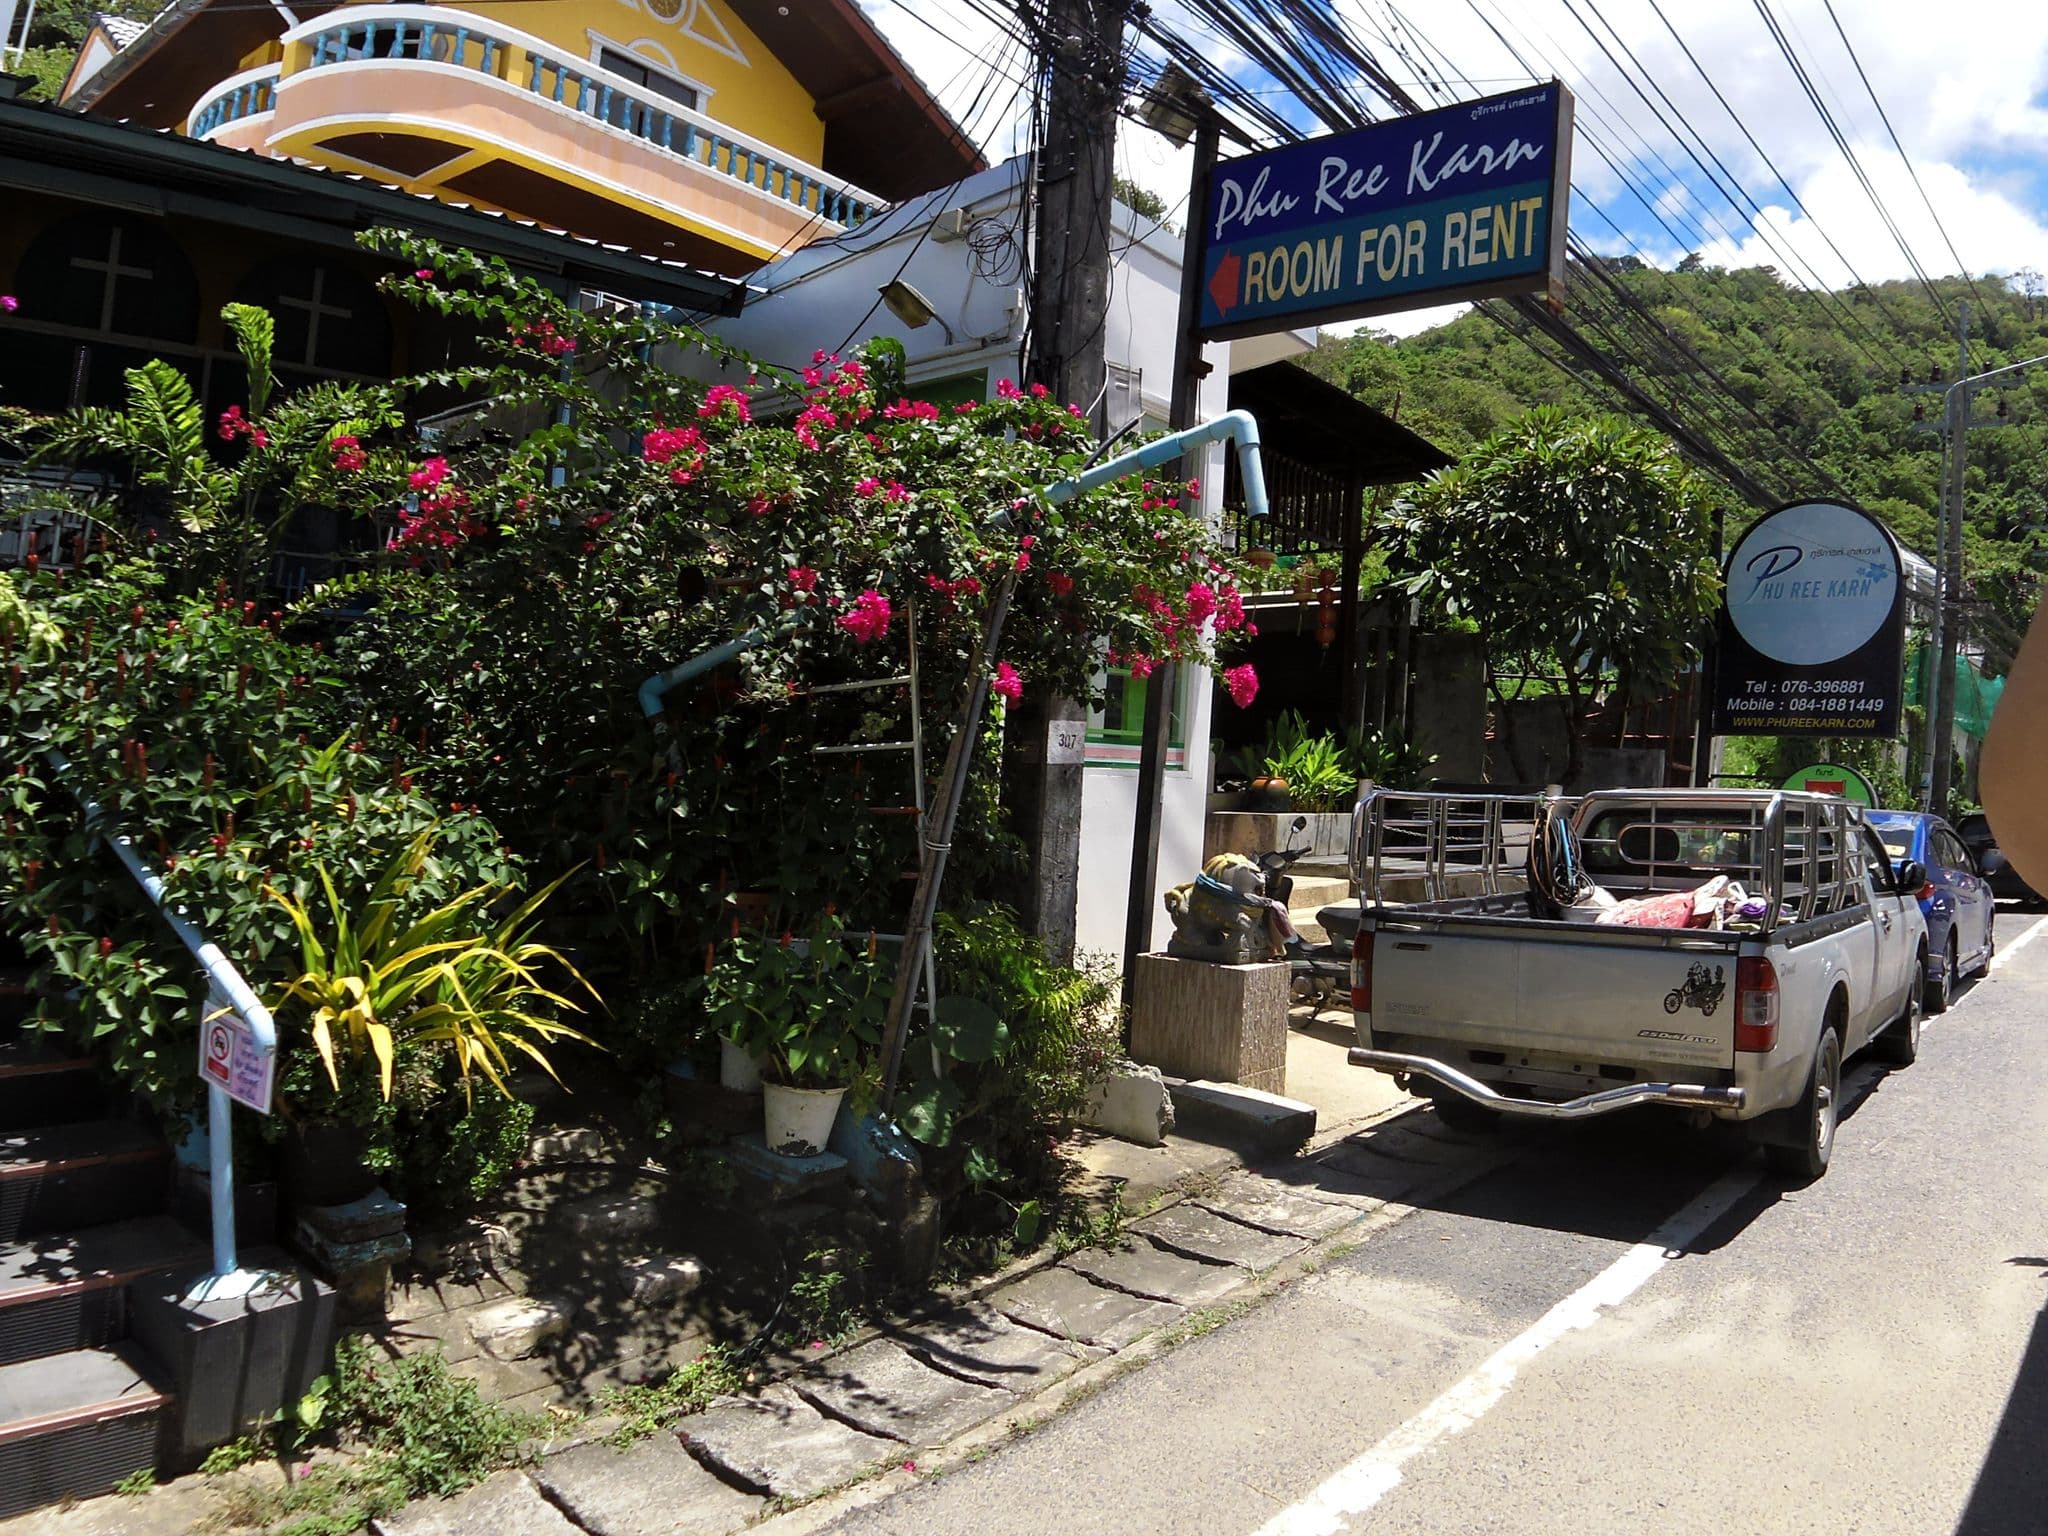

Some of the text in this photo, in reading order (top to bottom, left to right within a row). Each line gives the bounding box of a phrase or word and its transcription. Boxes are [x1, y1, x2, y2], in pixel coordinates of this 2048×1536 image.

[1215, 131, 1545, 240] Phu Ree Karn
[1244, 196, 1543, 305] ROOM FOR RENT
[1790, 580, 1821, 599] REE
[1826, 579, 1872, 598] KARN
[1745, 680, 1767, 694] Tel
[1780, 680, 1865, 694] 076-396881
[1727, 697, 1774, 712] Mobile
[1789, 697, 1884, 712] 084-1881449
[1732, 716, 1876, 730] WWW.PHUREEKARN.COM
